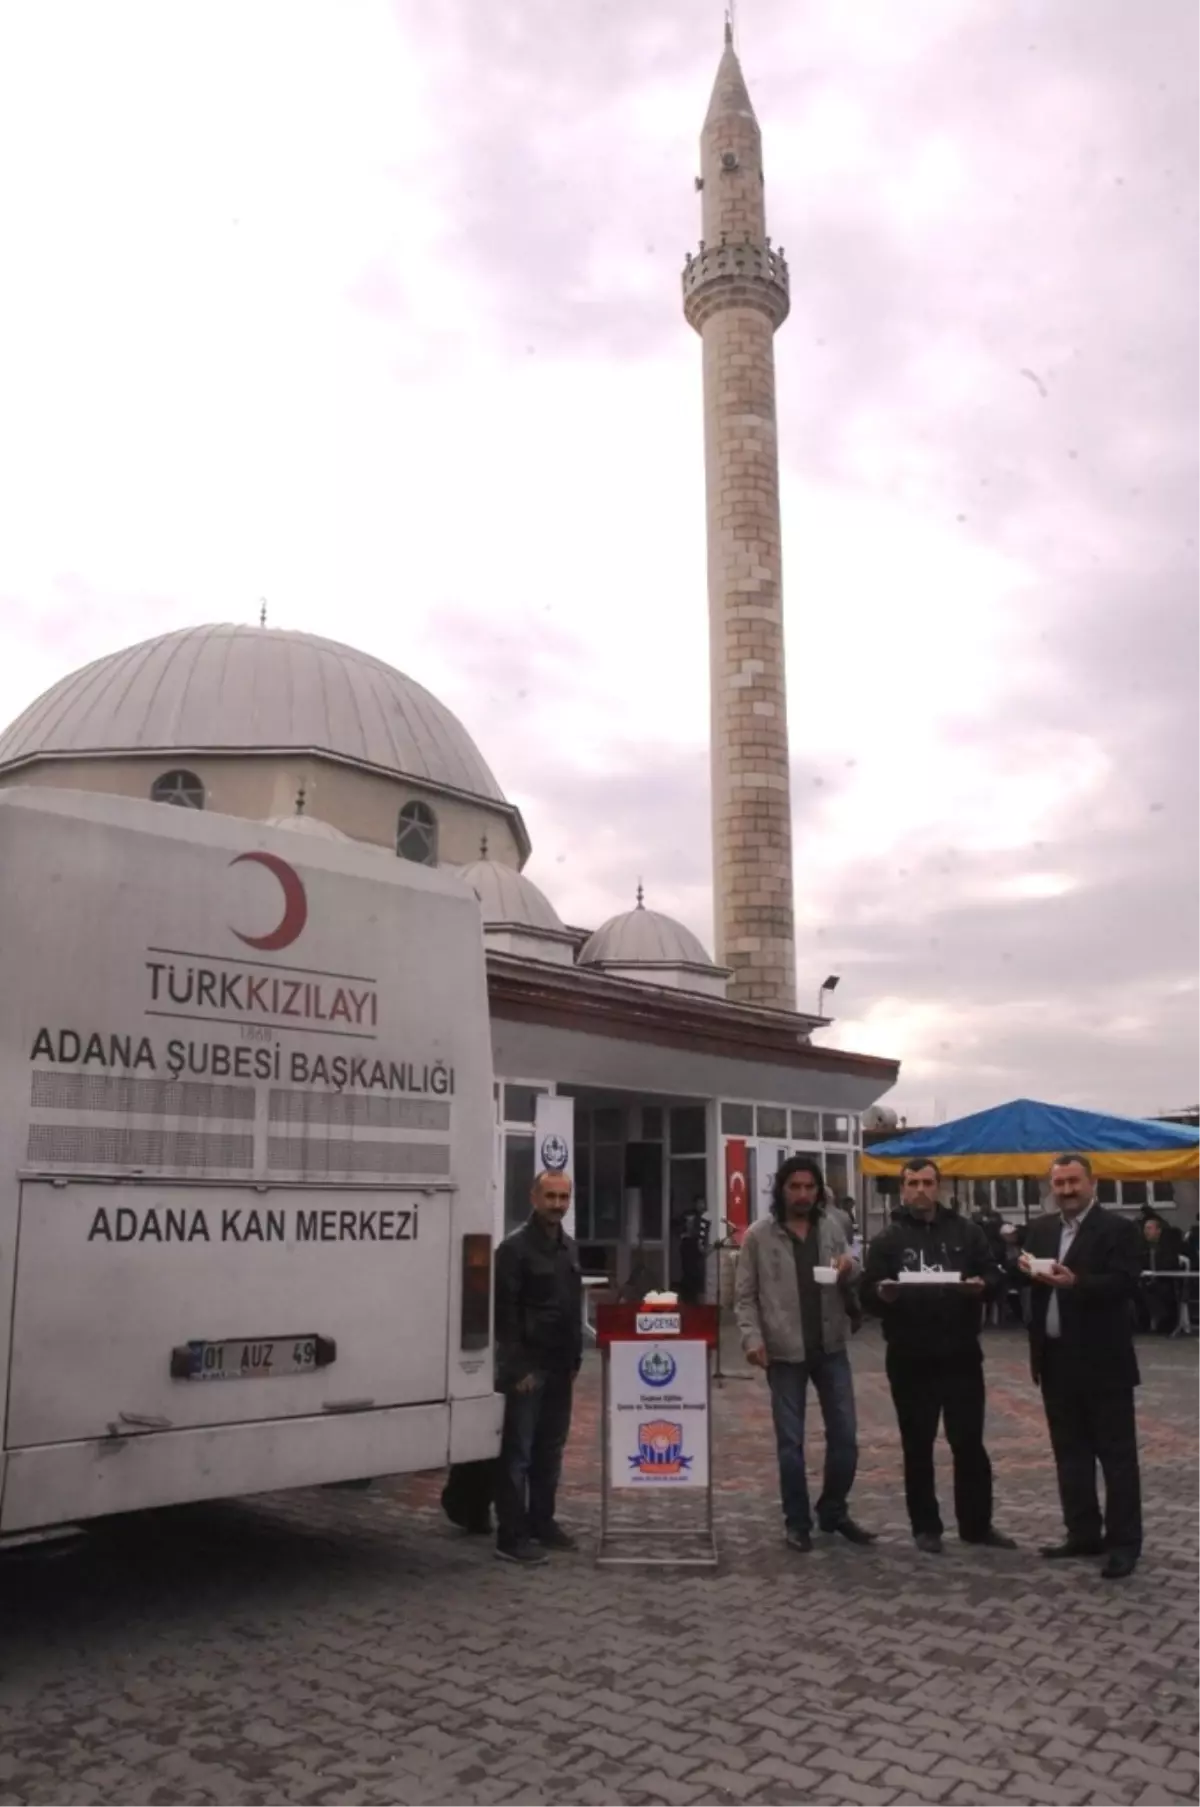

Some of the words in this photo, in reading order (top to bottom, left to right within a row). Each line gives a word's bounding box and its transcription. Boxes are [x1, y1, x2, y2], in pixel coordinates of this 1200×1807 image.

[30, 1028, 156, 1070] ADANA
[166, 1040, 281, 1080] ŞUBESİ
[290, 1052, 456, 1095] BAŞKANLIĞI
[88, 1207, 210, 1242] ADANA
[222, 1209, 285, 1242] KAN
[296, 1204, 419, 1241] MERKEZİ
[205, 1347, 223, 1370] 01
[240, 1344, 274, 1367] AUZ
